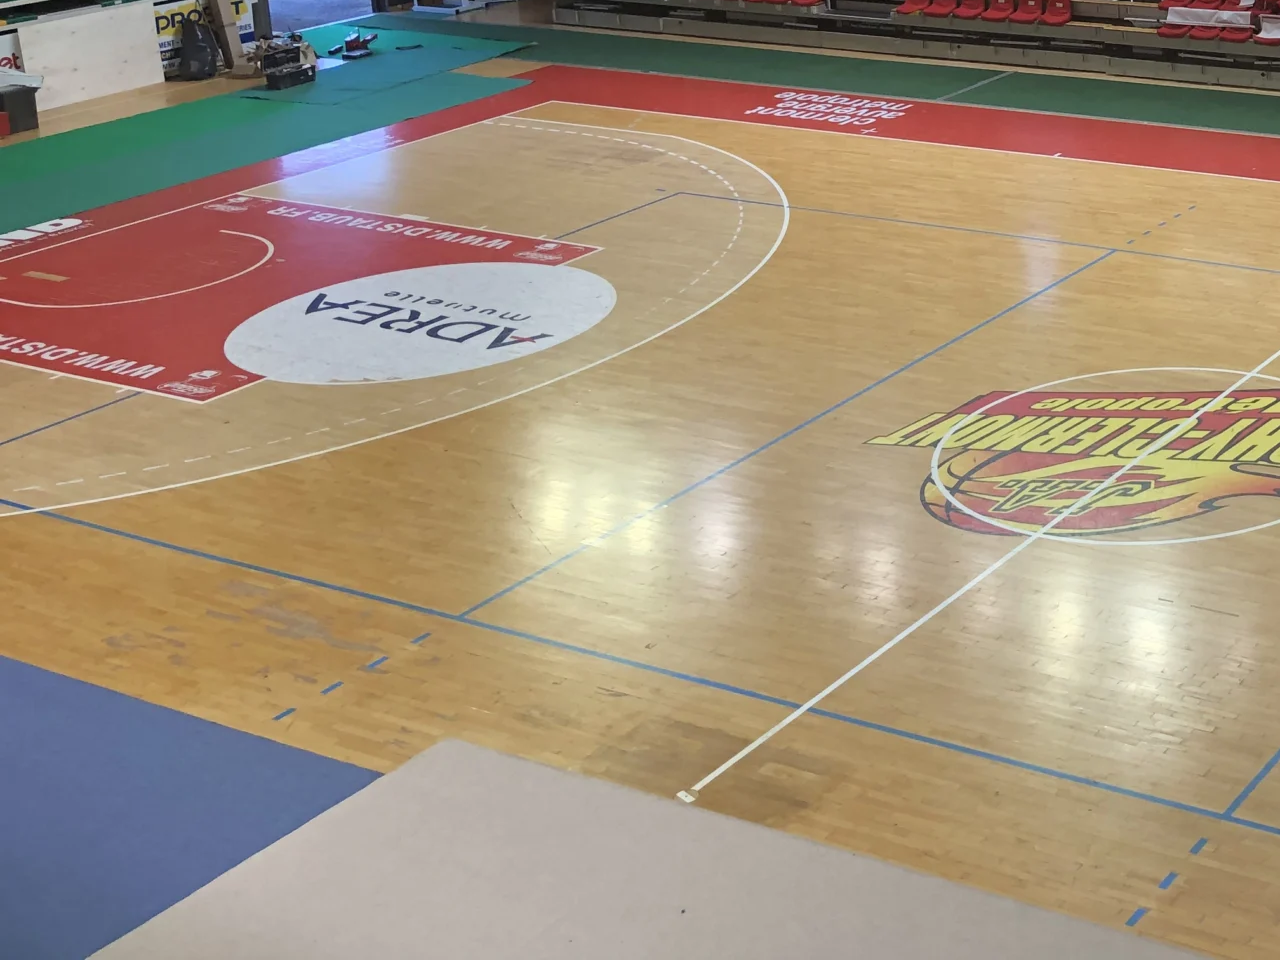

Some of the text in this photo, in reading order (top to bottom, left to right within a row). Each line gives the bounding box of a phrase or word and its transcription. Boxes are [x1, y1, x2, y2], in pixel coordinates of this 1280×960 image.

[744, 105, 877, 126] clermont
[776, 100, 906, 119] auvergne
[266, 206, 513, 250] WWW.DISTAUB.FR
[304, 292, 554, 351] ADREA
[384, 290, 532, 322] mutuelle
